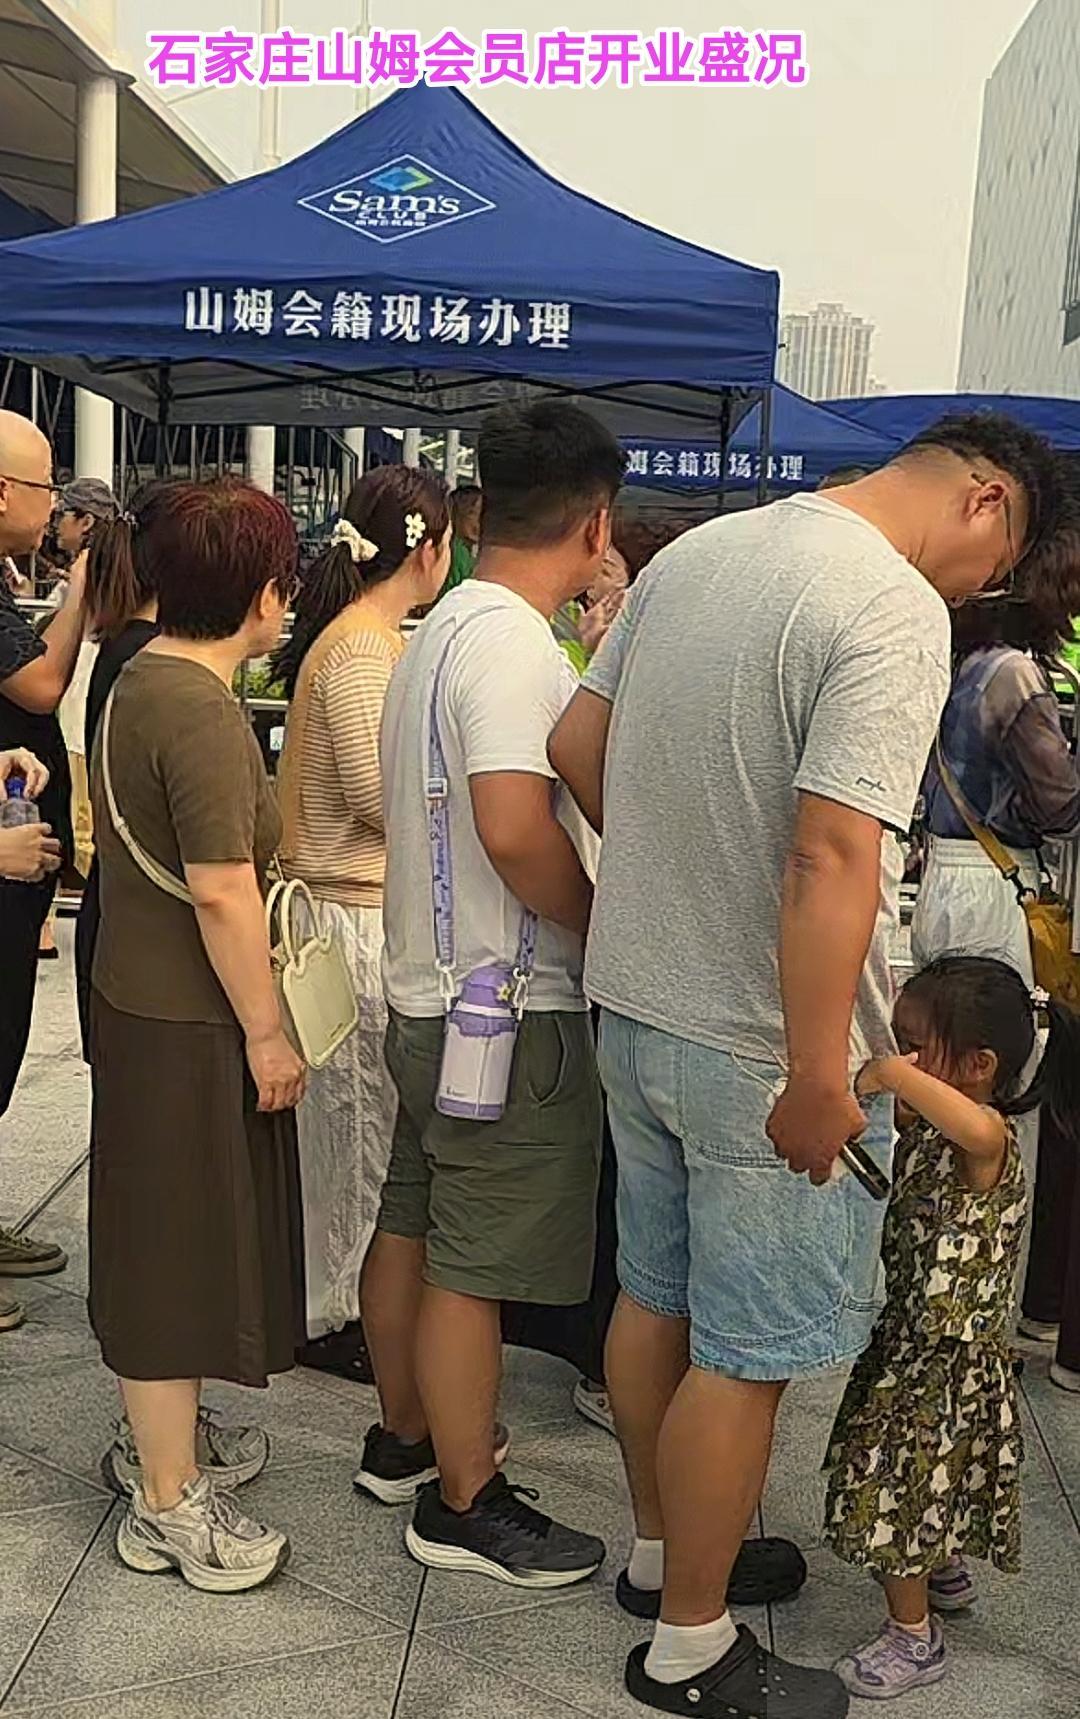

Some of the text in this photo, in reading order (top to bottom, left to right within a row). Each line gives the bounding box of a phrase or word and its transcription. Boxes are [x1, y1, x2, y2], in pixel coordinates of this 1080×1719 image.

[329, 190, 461, 215] Sam's
[185, 287, 572, 348] 山姆会籍现场办理
